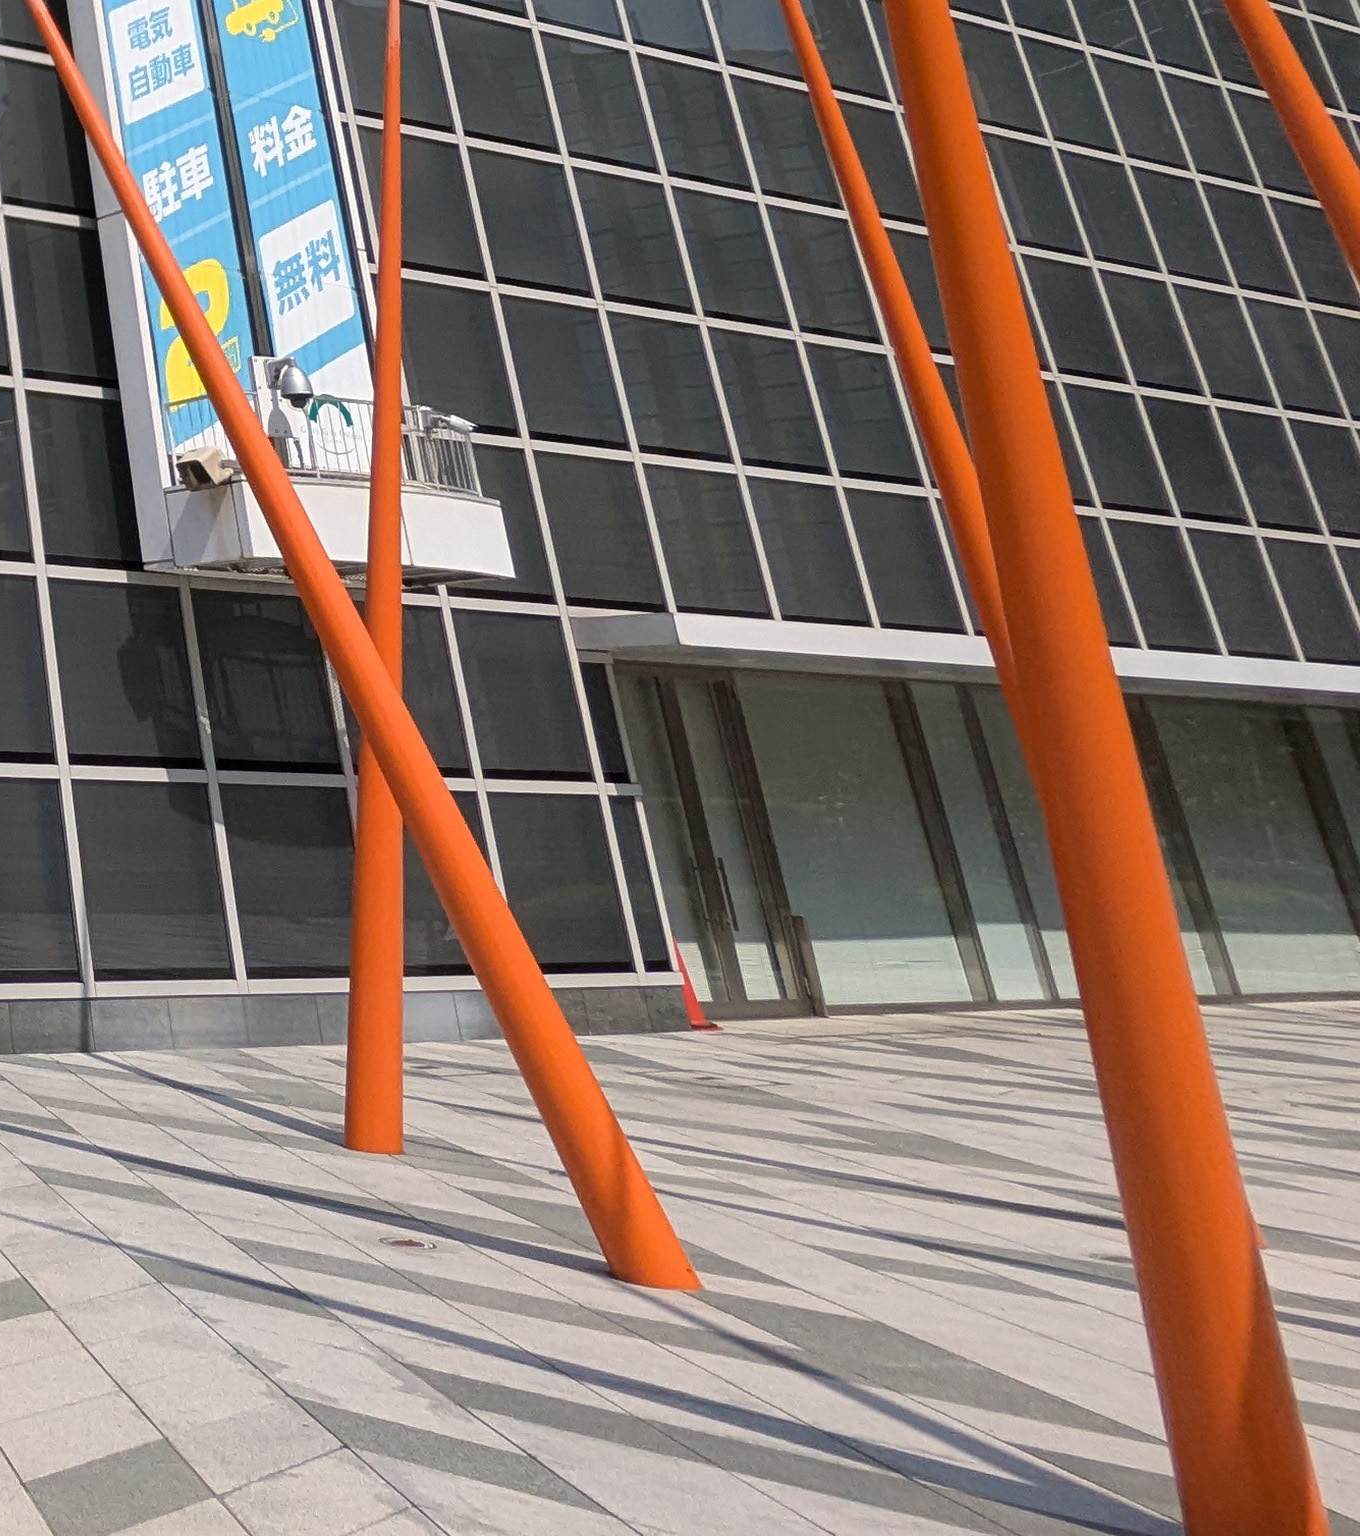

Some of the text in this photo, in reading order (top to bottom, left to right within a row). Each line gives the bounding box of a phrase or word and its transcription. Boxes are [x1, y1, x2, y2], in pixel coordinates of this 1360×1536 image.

[127, 6, 173, 51] 電気
[129, 42, 195, 101] 自動車
[142, 105, 317, 223] 駐車 料金
[272, 229, 341, 316] 無料
